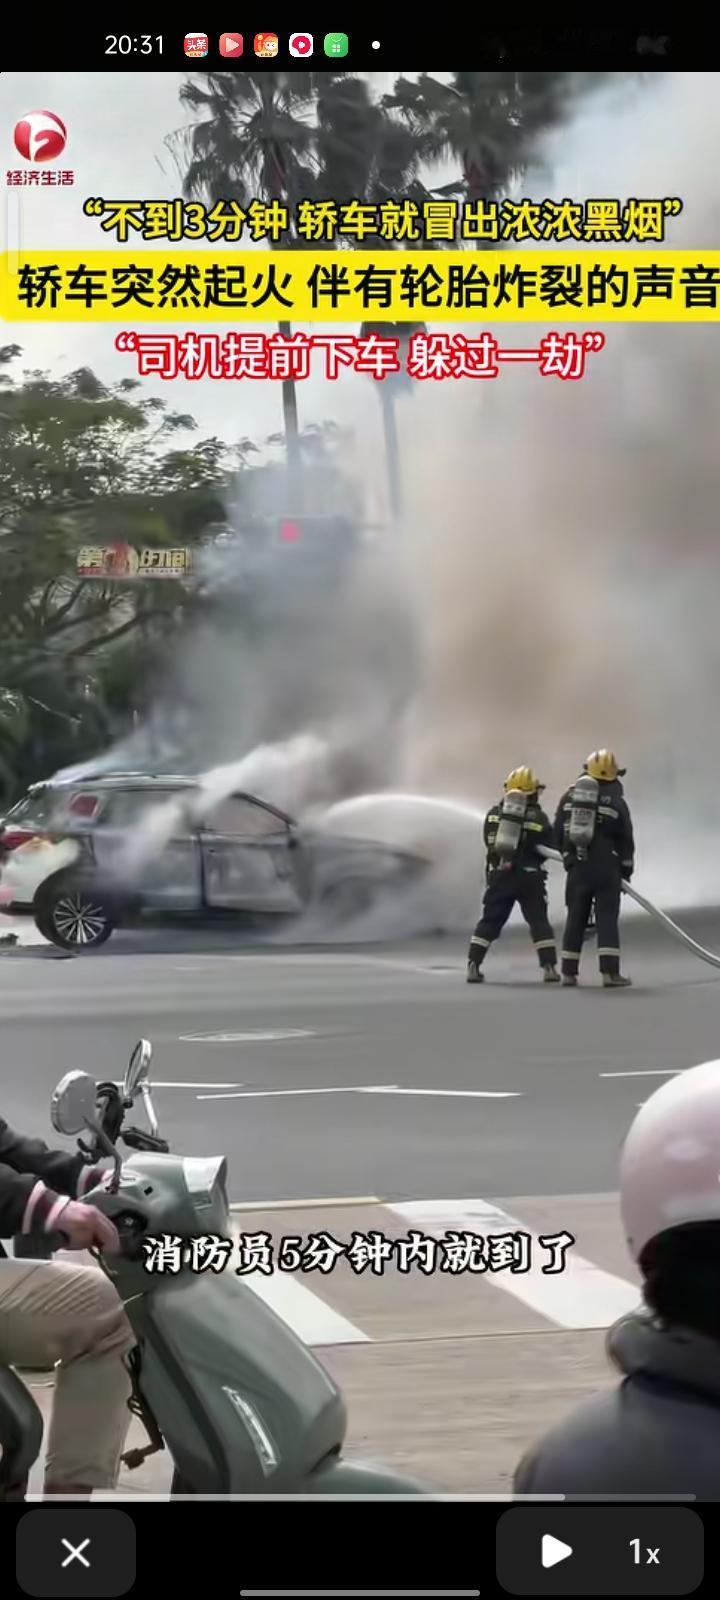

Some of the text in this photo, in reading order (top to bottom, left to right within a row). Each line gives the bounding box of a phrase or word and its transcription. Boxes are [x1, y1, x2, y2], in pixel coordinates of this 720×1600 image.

[104, 34, 163, 55] 20:31
[187, 39, 207, 51] 头条
[628, 1538, 661, 1564] 1x
